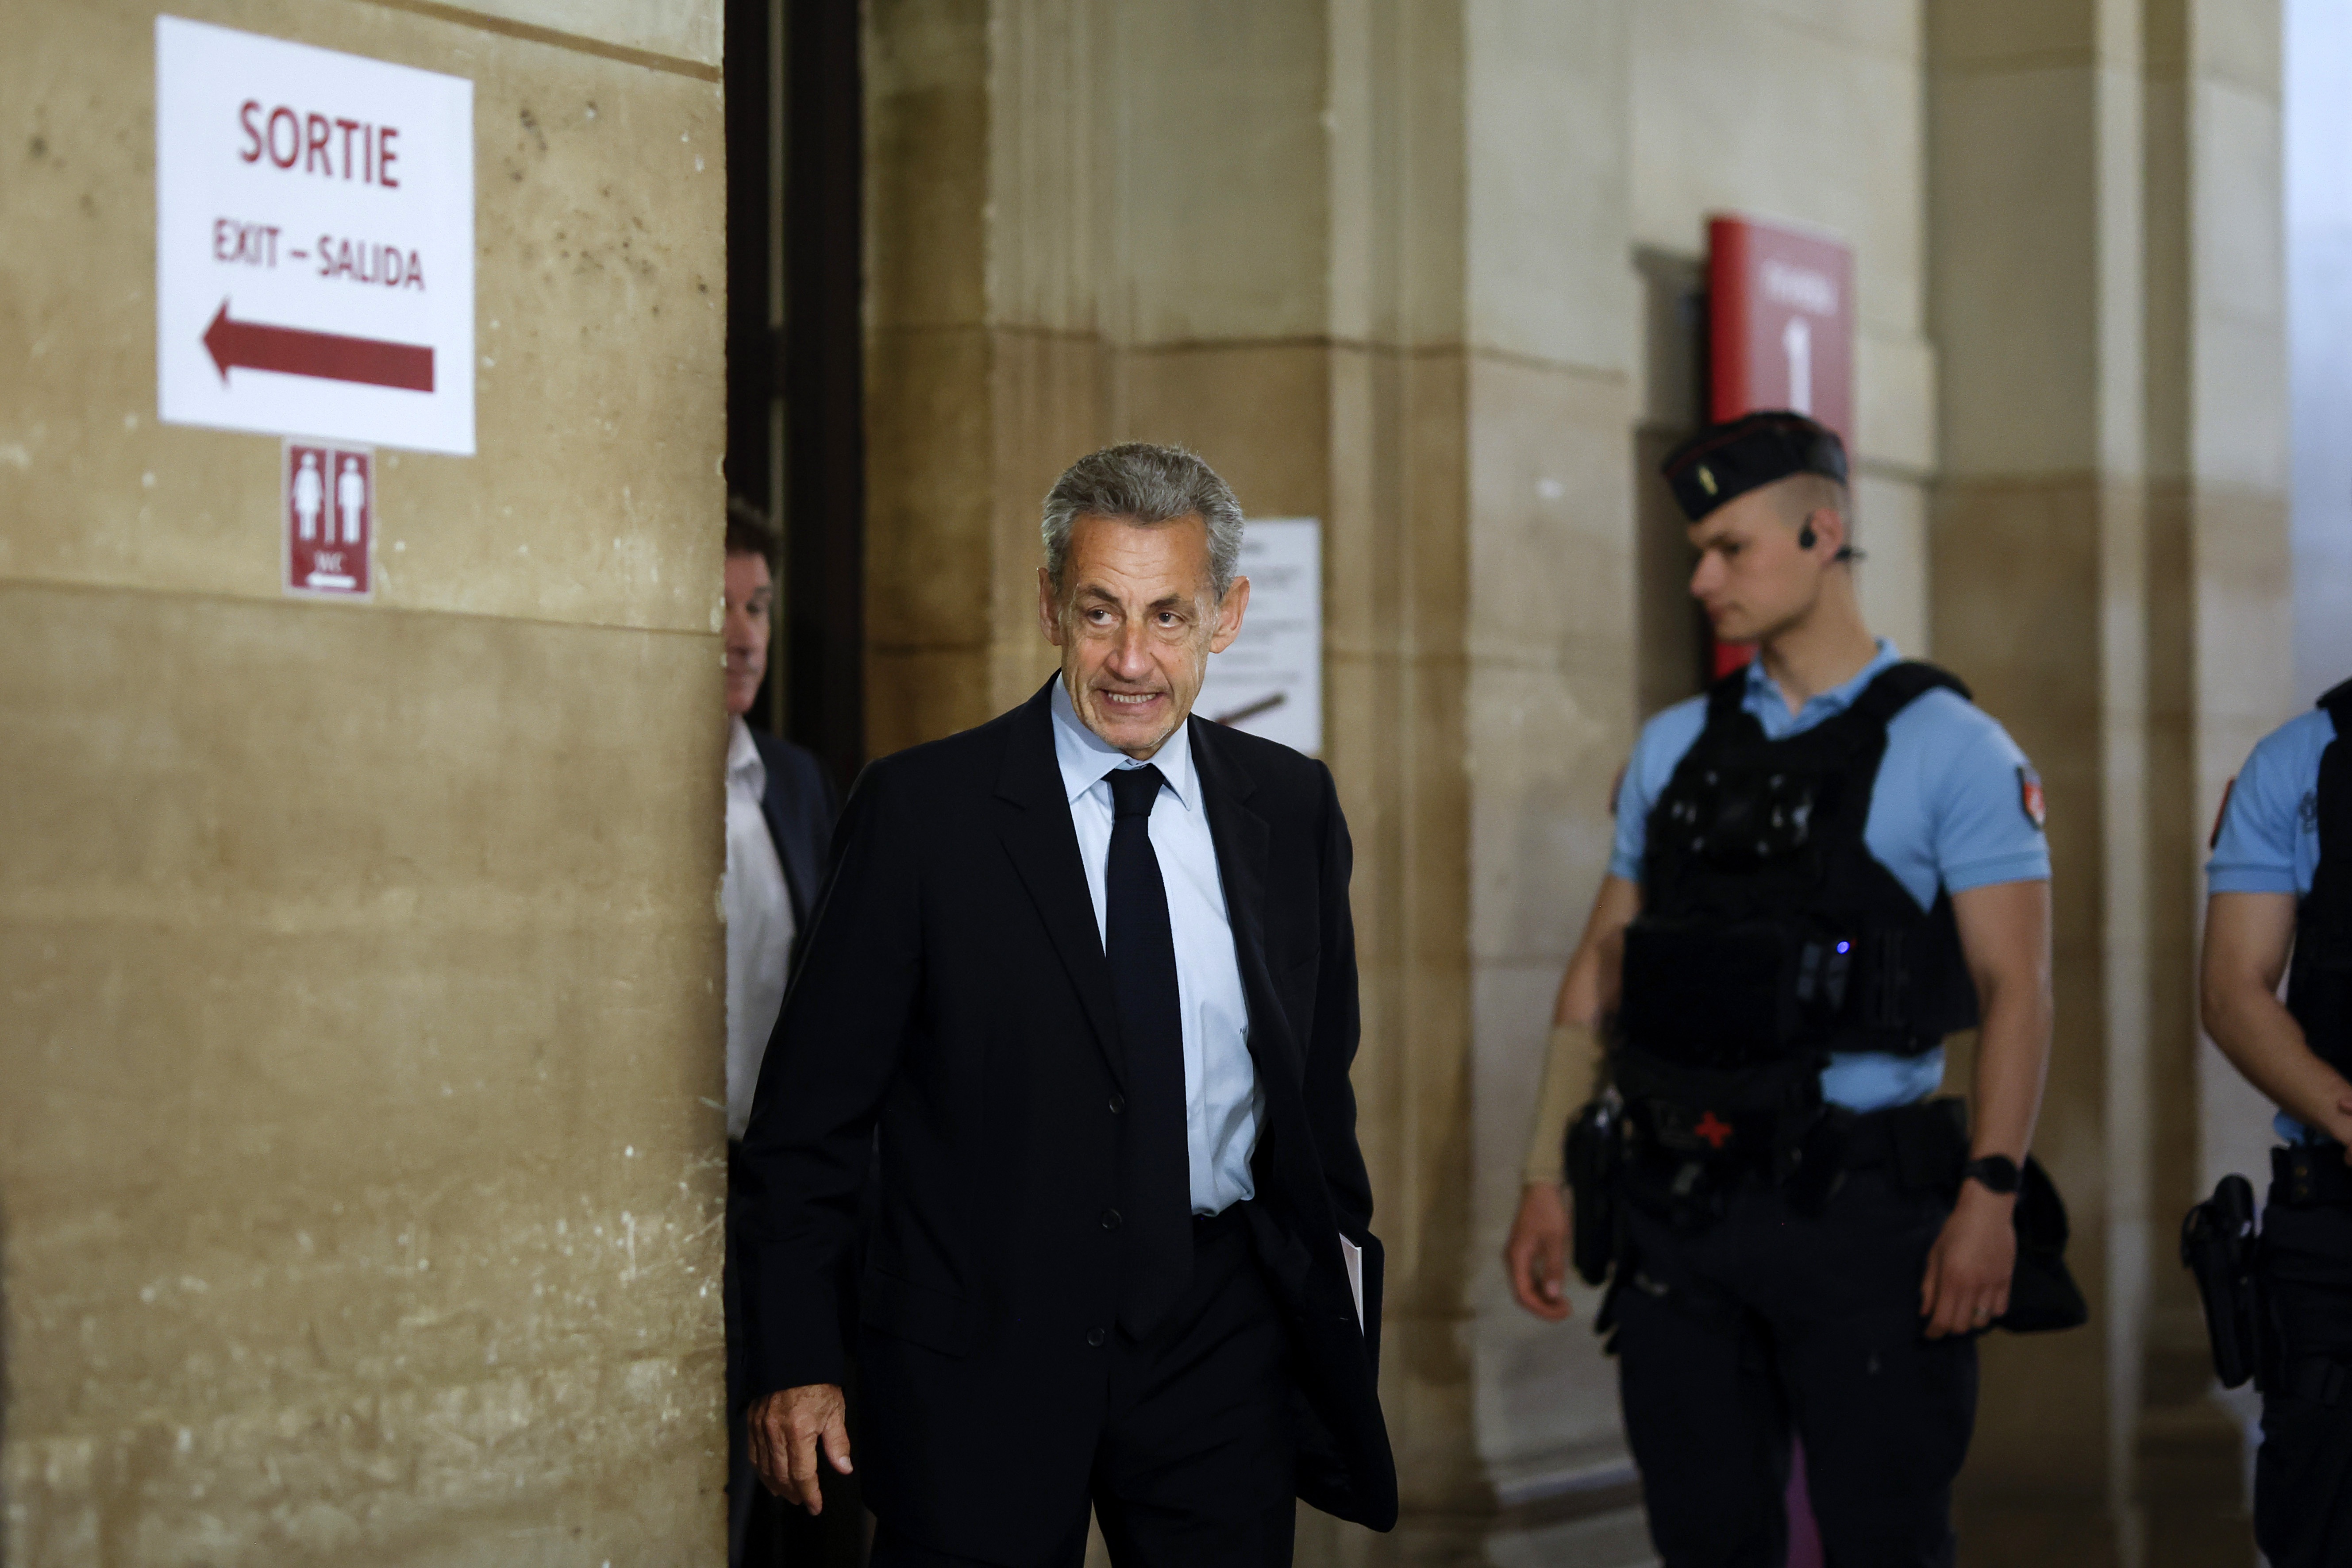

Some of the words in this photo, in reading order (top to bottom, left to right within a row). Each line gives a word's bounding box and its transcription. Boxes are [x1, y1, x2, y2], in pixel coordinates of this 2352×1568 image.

[239, 99, 399, 189] SORTIE
[213, 218, 281, 267] EXIT
[318, 235, 424, 290] SALIDA
